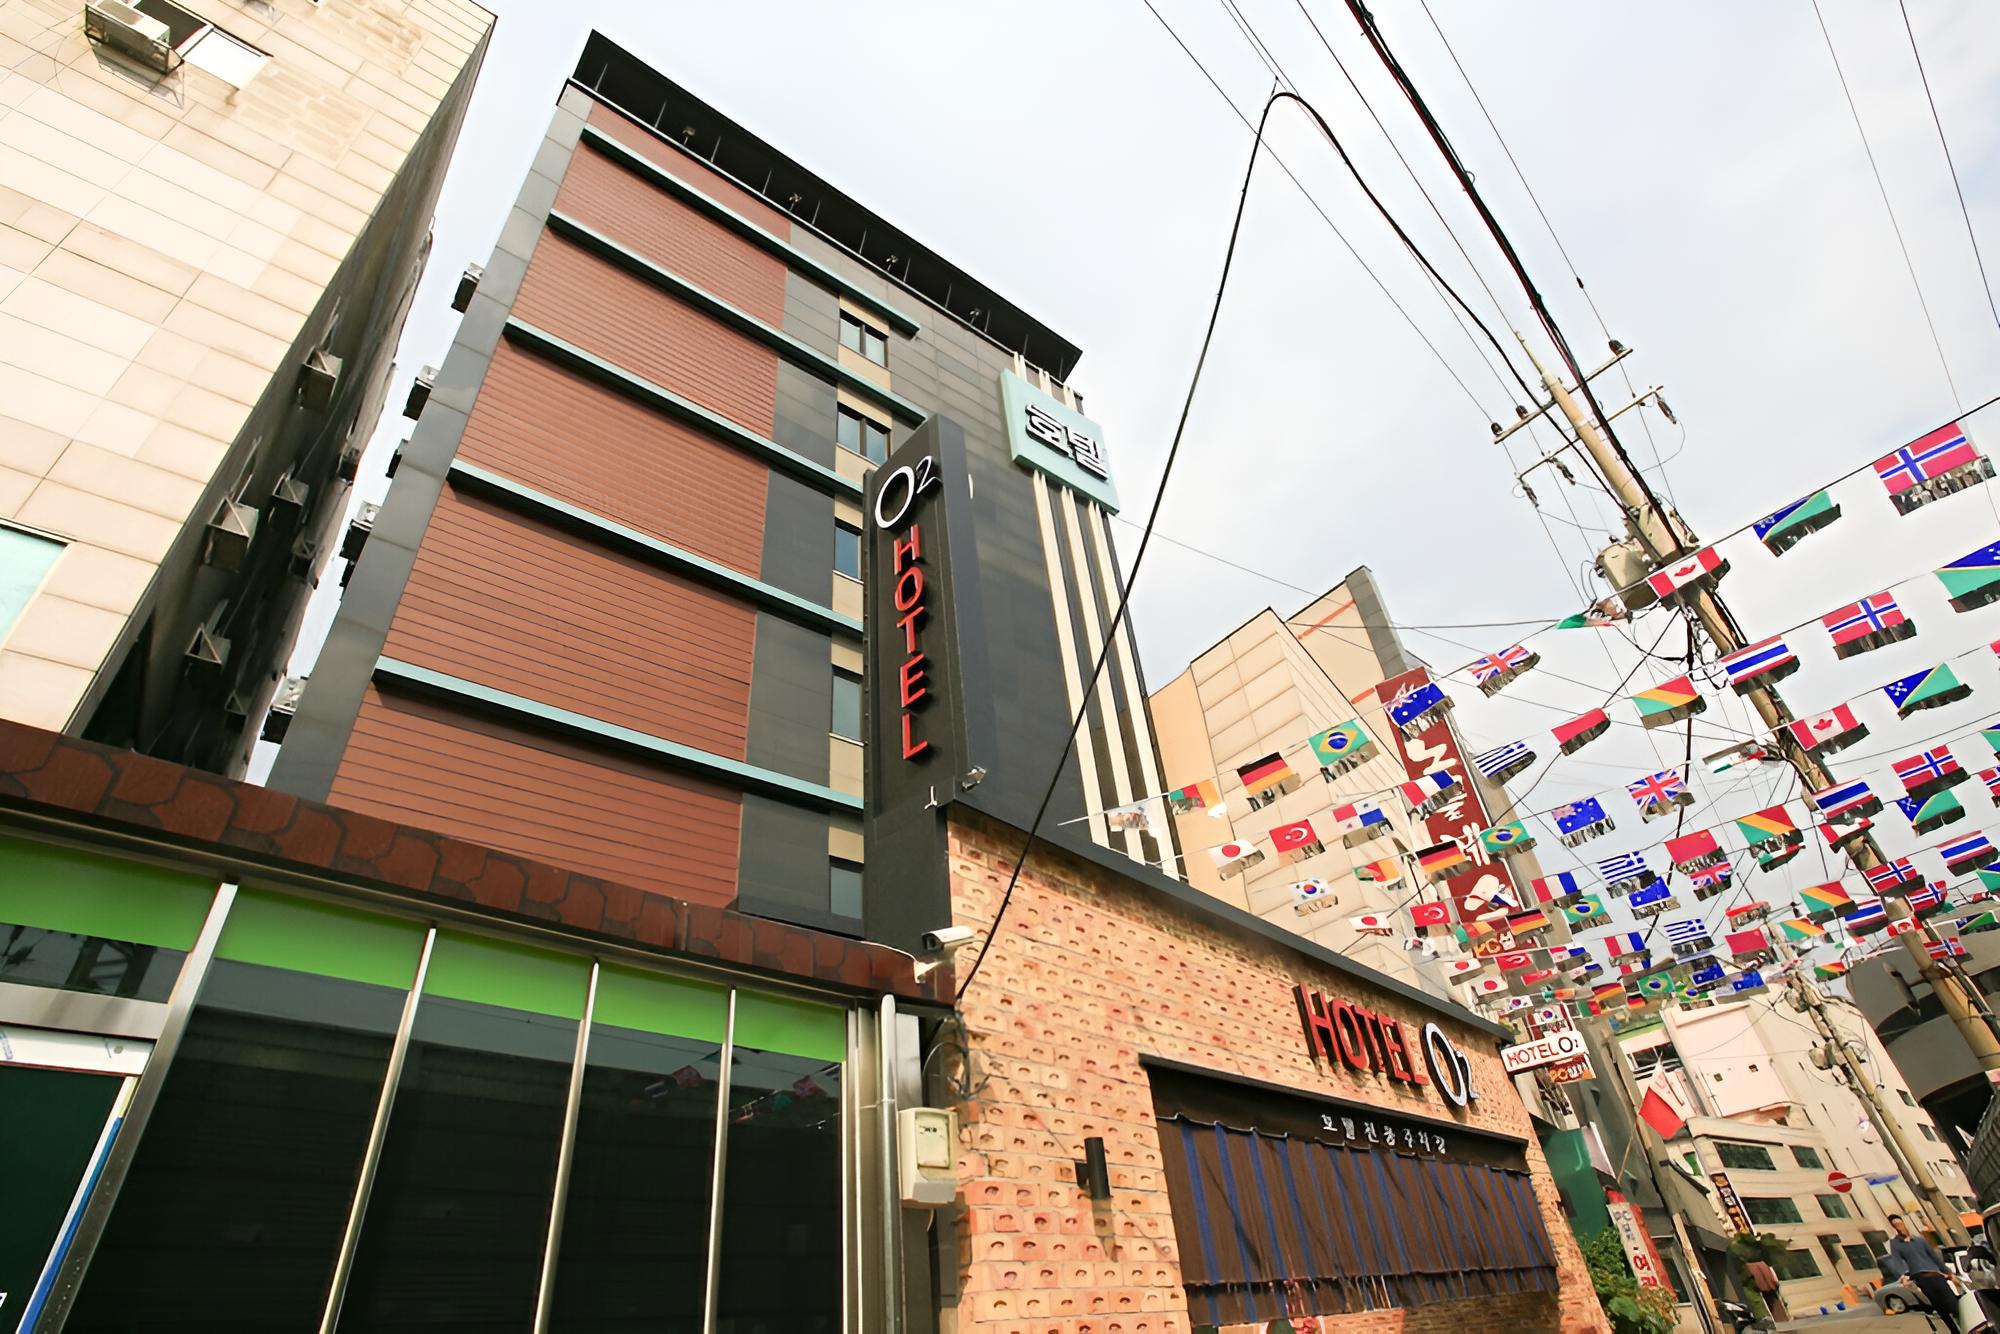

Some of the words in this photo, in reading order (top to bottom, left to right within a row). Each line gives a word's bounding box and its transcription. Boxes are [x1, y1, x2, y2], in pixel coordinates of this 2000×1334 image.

[893, 523, 929, 760] HOTEL
[1294, 982, 1430, 1086] HOTEL
[1506, 1042, 1559, 1068] HOTEL
